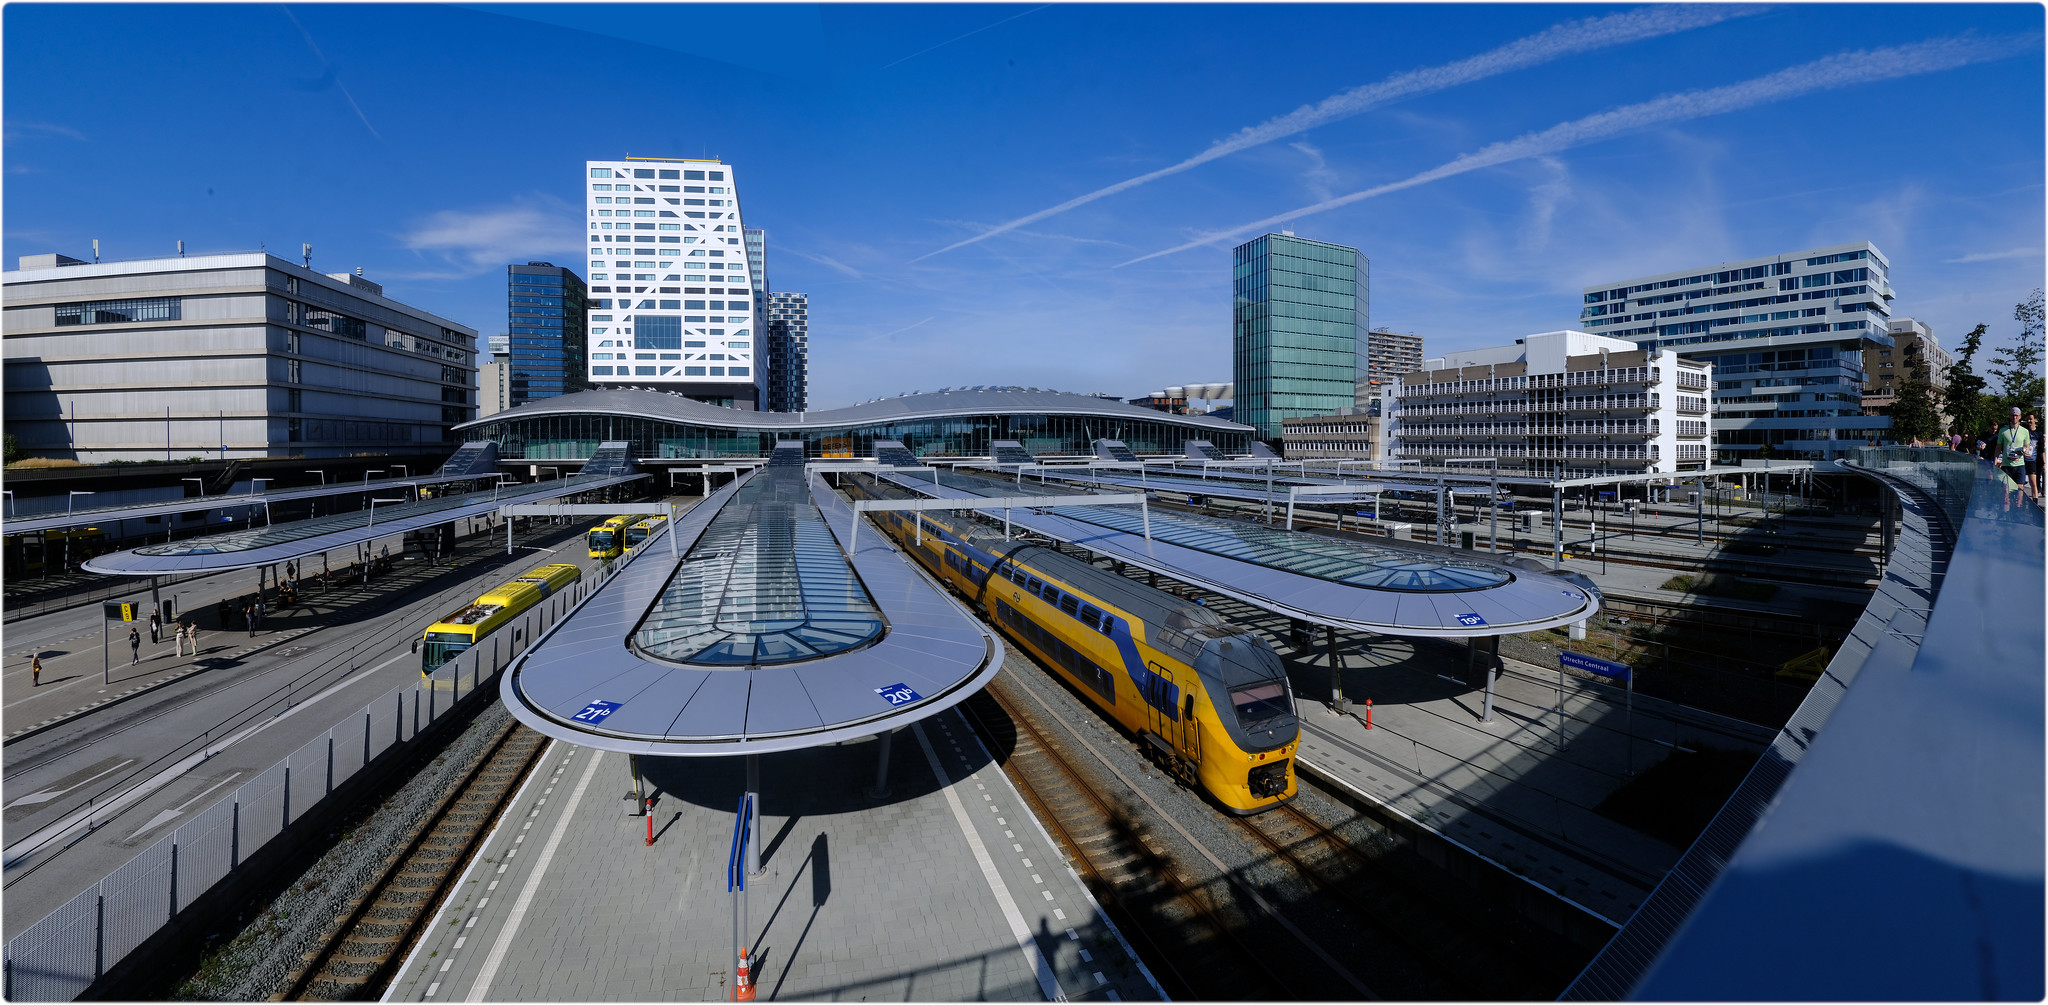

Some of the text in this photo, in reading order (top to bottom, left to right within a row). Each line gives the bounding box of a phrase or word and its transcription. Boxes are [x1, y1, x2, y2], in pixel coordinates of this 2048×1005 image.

[1098, 621, 1104, 632] 2
[1562, 655, 1609, 672] Utrecht Centraal
[1096, 667, 1102, 679] 2
[884, 687, 913, 704] 20b
[575, 707, 611, 721] 21b
